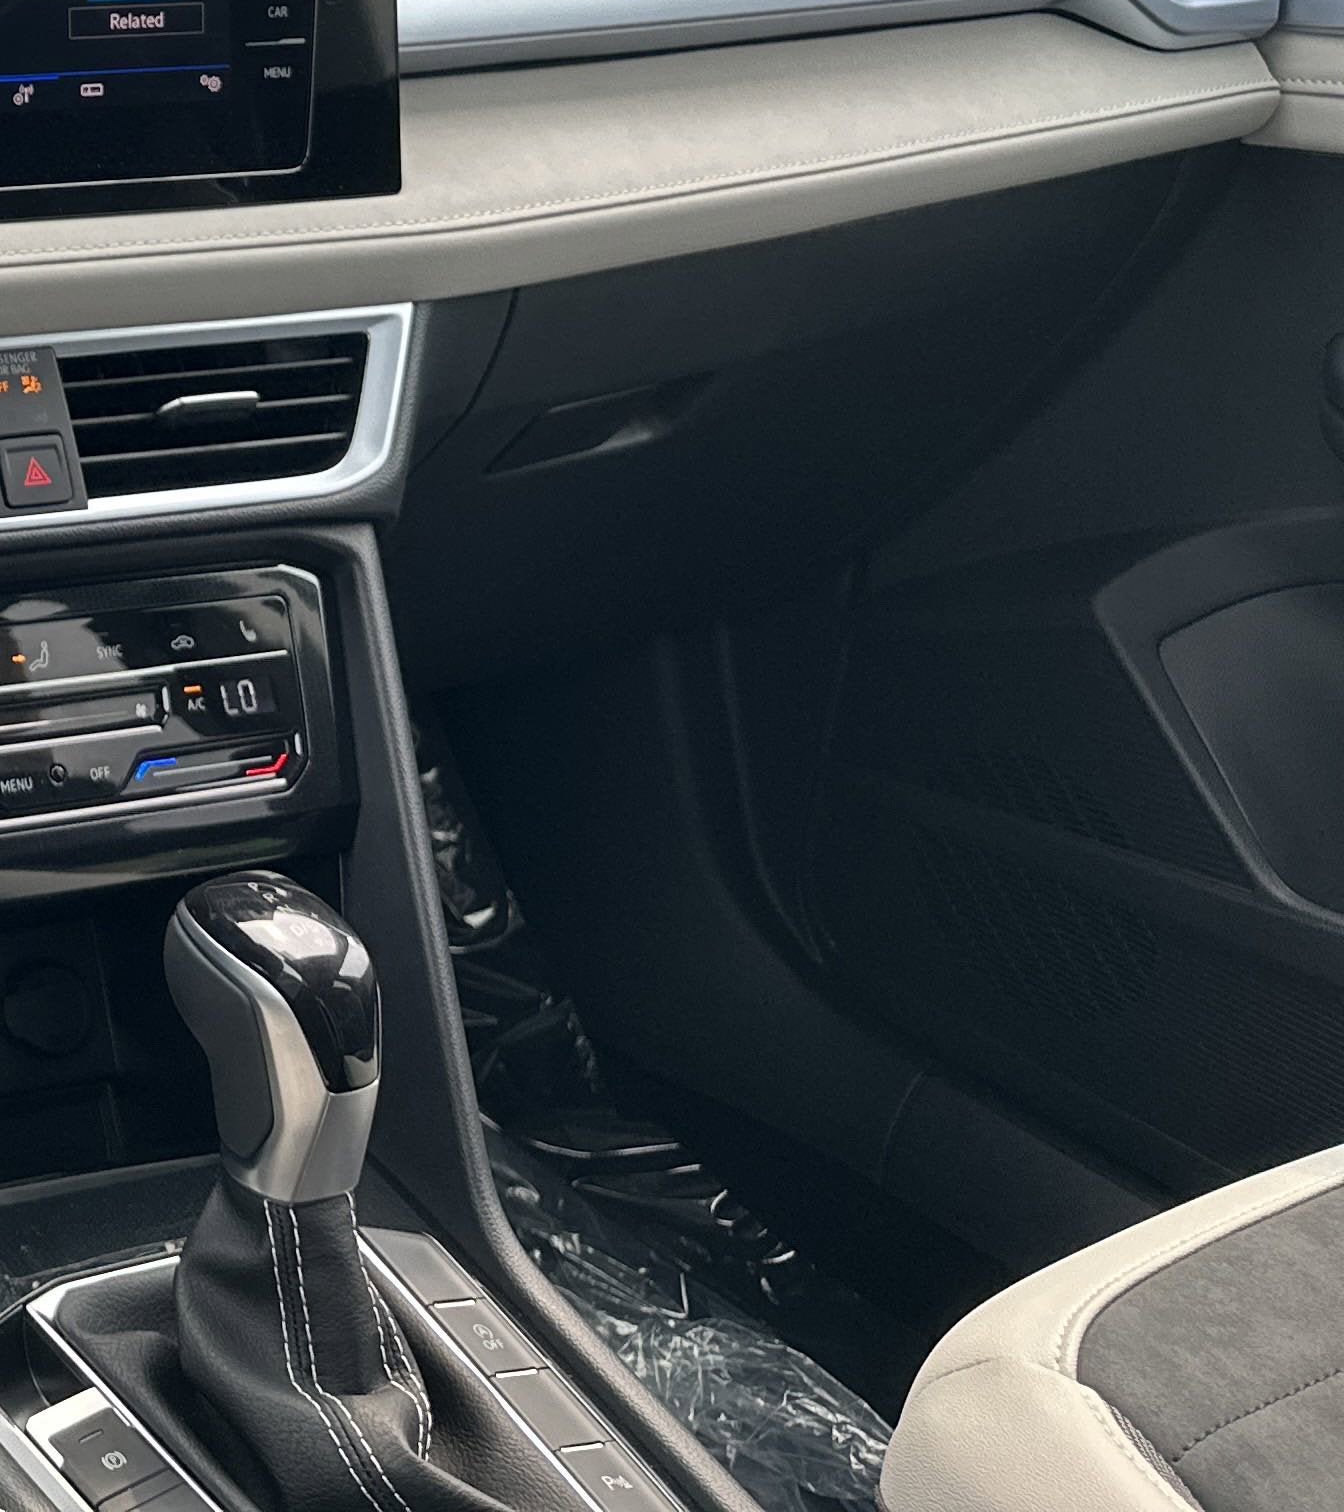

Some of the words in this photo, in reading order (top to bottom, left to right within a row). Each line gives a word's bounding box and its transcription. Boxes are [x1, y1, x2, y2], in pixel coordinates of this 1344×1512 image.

[267, 5, 289, 19] CAR
[109, 11, 166, 32] Related
[263, 66, 293, 80] MENU
[95, 643, 123, 660] SYNC
[187, 696, 207, 712] A/C
[221, 678, 258, 716] LO
[89, 764, 111, 783] OFF
[0, 775, 34, 795] MENU
